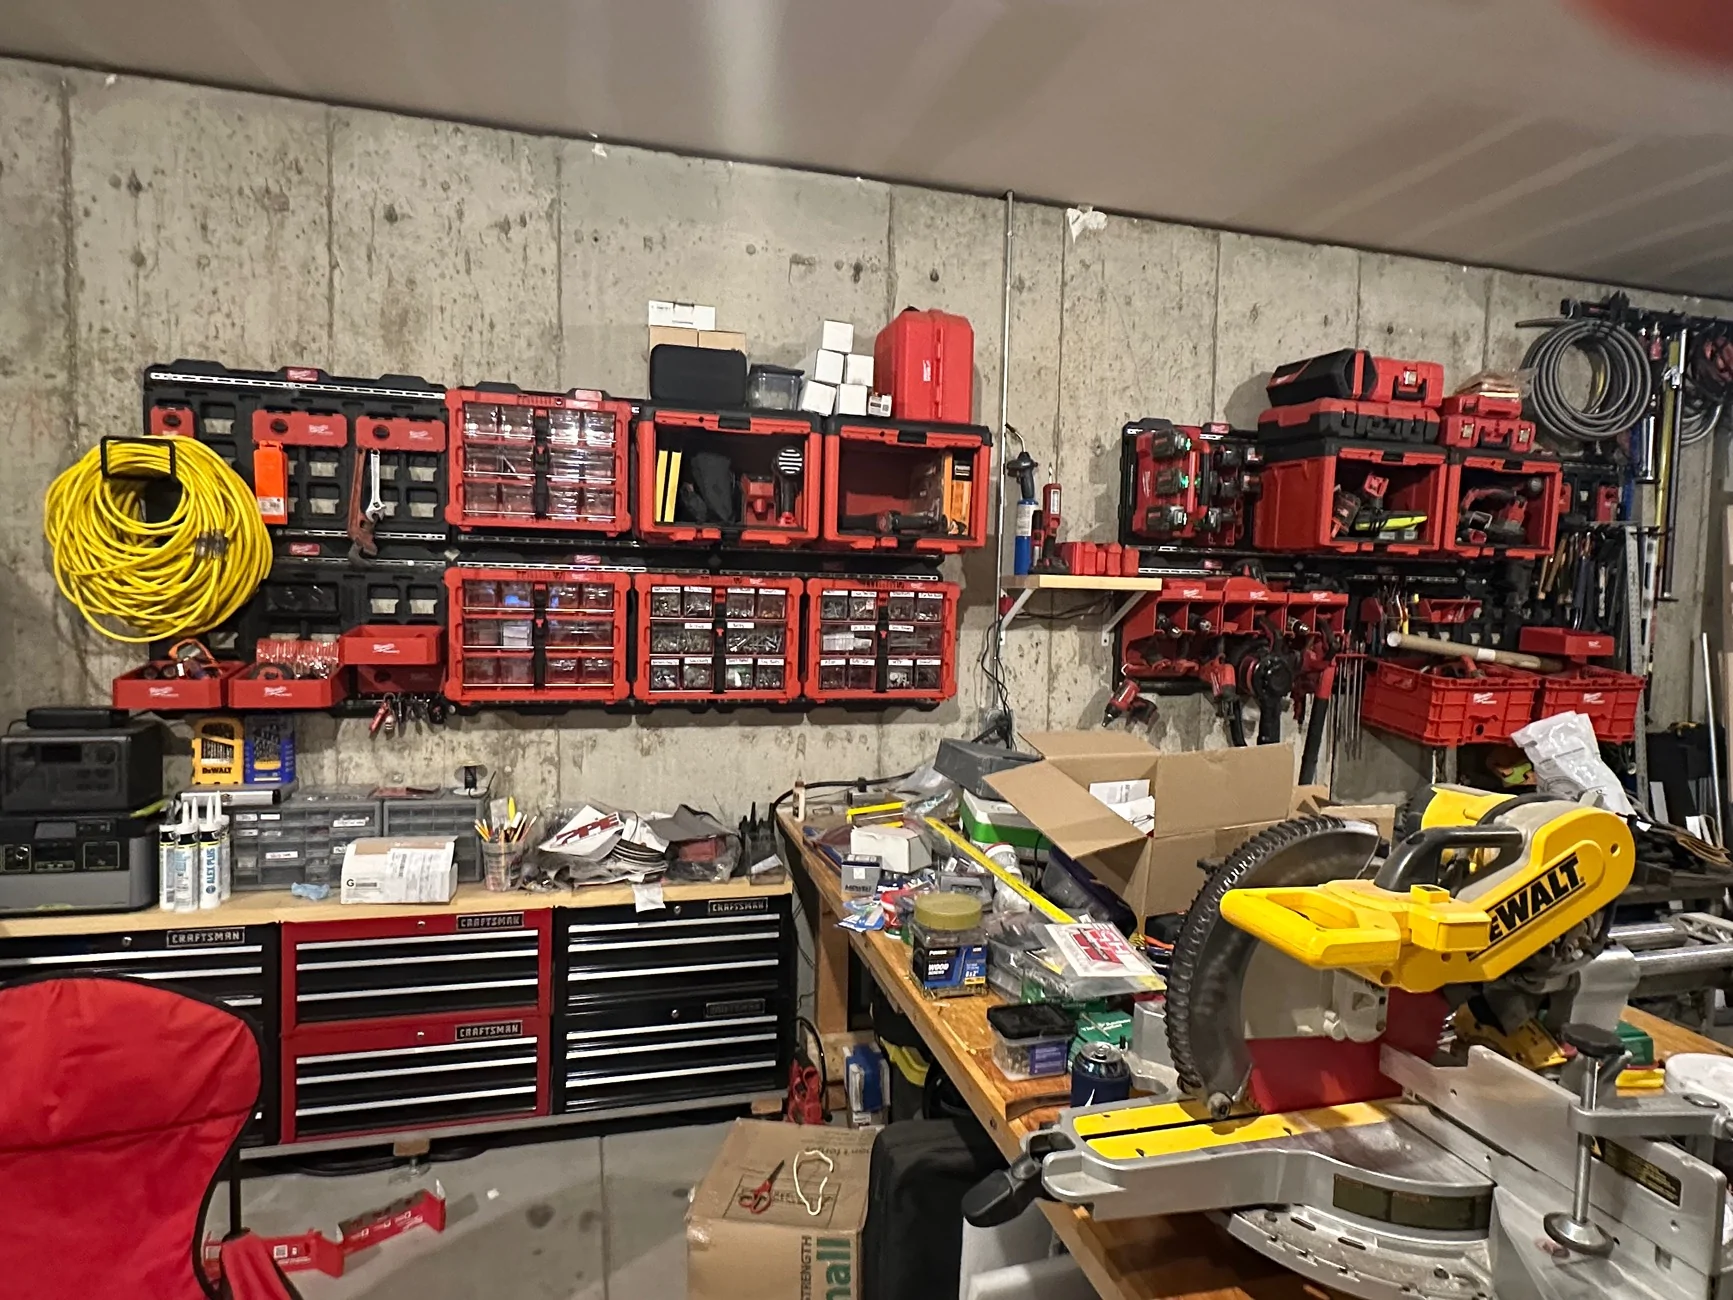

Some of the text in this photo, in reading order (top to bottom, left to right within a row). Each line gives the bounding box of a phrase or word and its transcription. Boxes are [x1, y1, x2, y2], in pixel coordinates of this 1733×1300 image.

[206, 848, 215, 884] ALEX PLUS
[1490, 855, 1580, 943] EWALT
[461, 915, 520, 927] CRAFTSMAN
[171, 931, 240, 943] CRAFTSMAN
[459, 1024, 519, 1038] CRAFTSMAN
